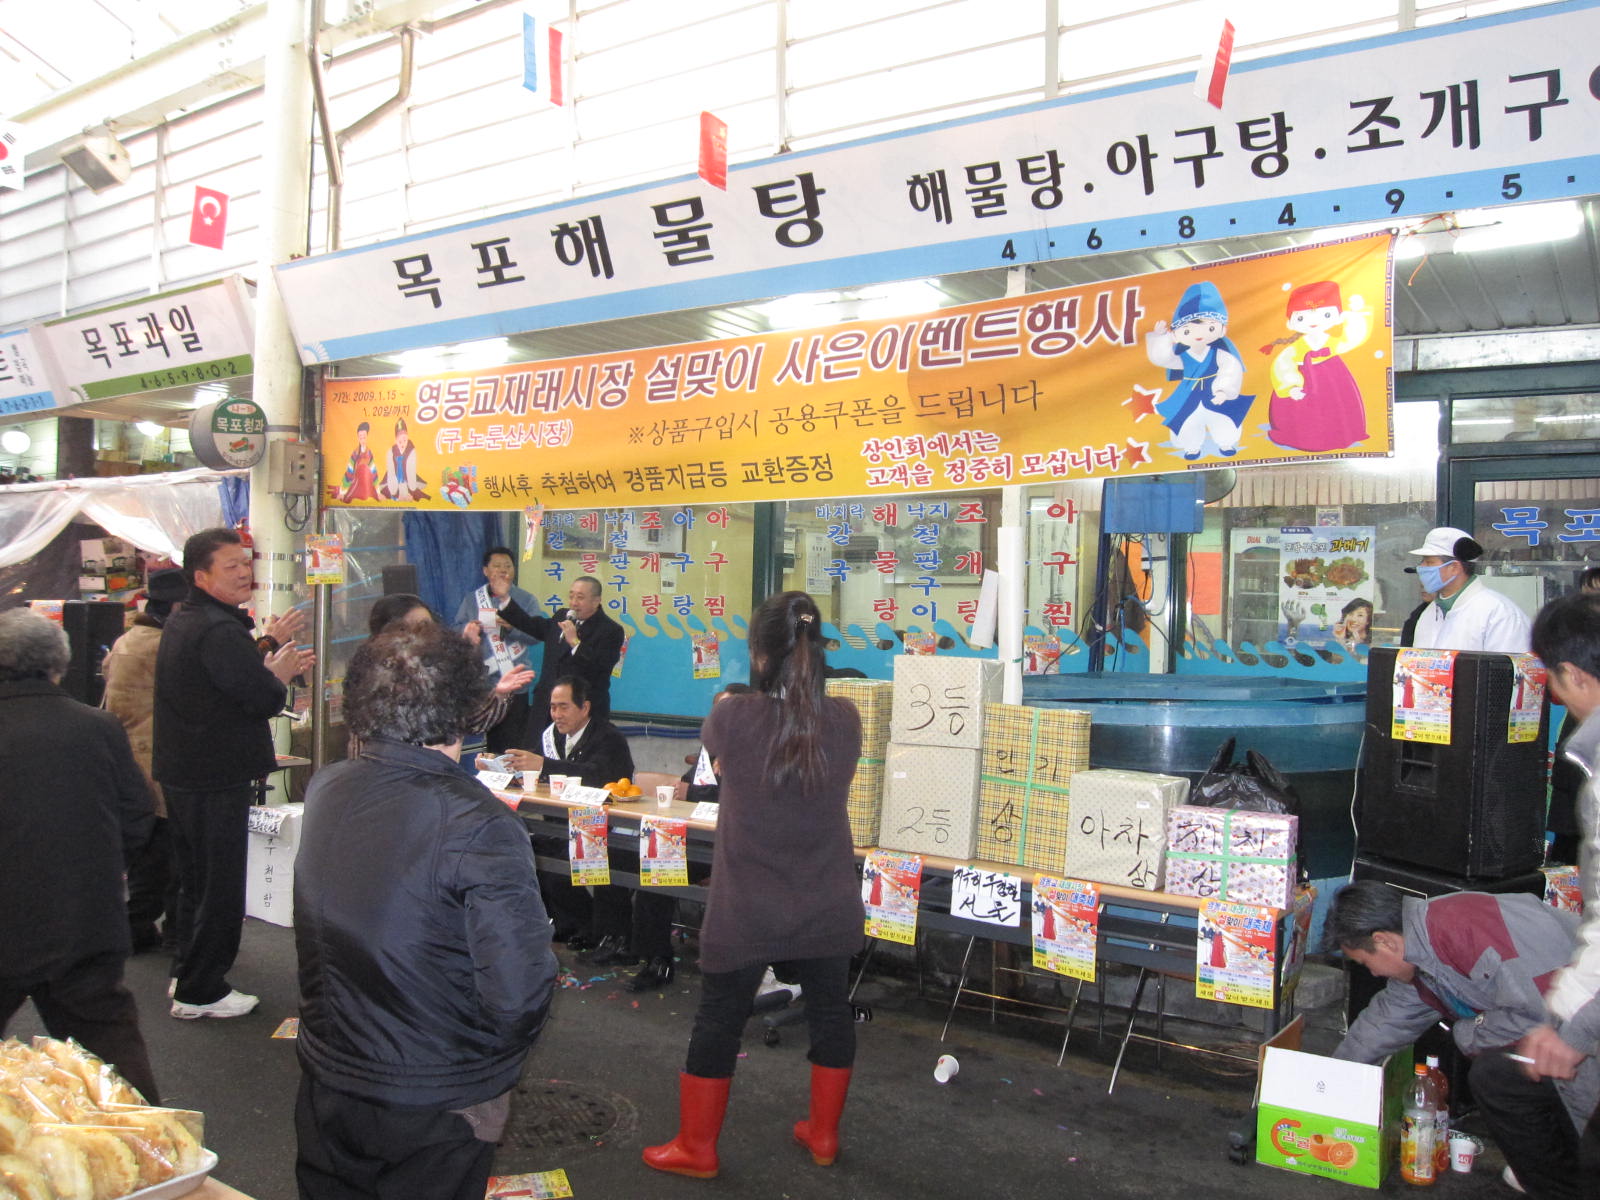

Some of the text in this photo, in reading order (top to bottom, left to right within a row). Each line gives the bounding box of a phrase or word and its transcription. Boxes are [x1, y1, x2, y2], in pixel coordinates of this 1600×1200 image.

[391, 171, 828, 310] 목포해물탕
[80, 304, 204, 370] 목포과일
[416, 286, 1144, 424] 영동교재래시장 설맞이 사은이벤트행사
[353, 390, 397, 402] 2009.1.15
[372, 404, 410, 417] 20일까지
[768, 393, 906, 437] 공용쿠폰을
[915, 378, 1045, 422] 드립니다
[861, 431, 1001, 465] 상인회에서는
[866, 445, 1122, 489] 고객을 정중히 모십니다
[482, 453, 834, 500] 행사후 추첨하여 경품지급등 교환증정
[604, 511, 636, 527] 낙지
[815, 502, 866, 521] 바지락
[906, 502, 950, 520] 낙지
[1329, 537, 1370, 553] 과메기
[906, 682, 971, 736] 3등
[896, 805, 953, 845] 2등
[990, 799, 1023, 843] 상
[1080, 808, 1150, 856] 아차
[1127, 859, 1158, 888] 상
[1192, 865, 1222, 898] 상
